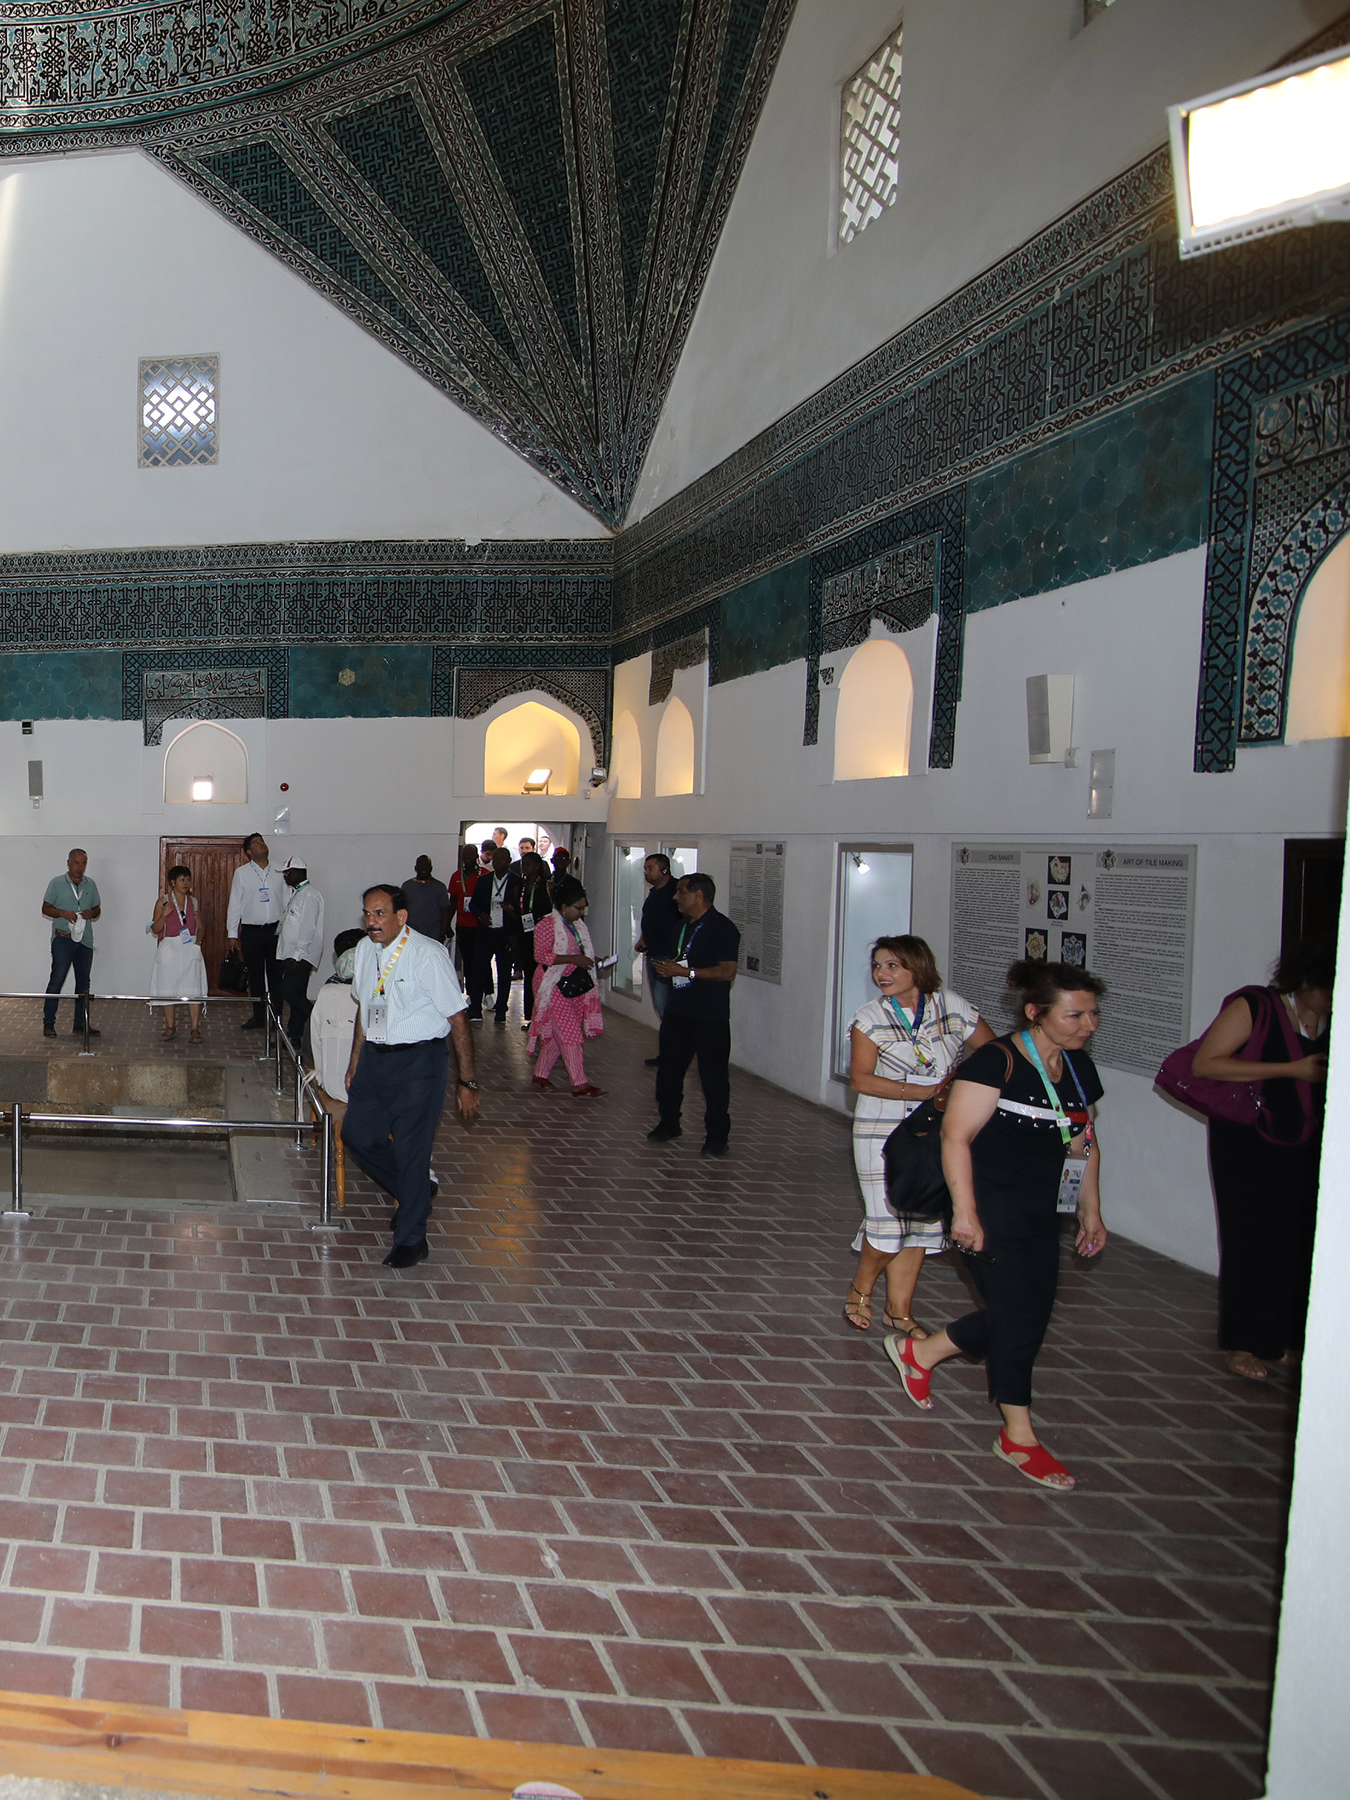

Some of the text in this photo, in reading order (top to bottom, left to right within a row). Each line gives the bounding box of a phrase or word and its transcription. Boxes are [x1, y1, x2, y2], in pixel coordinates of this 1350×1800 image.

[1145, 859, 1158, 867] TILE
[1159, 860, 1183, 868] MAKING
[1029, 1095, 1084, 1108] TOMY
